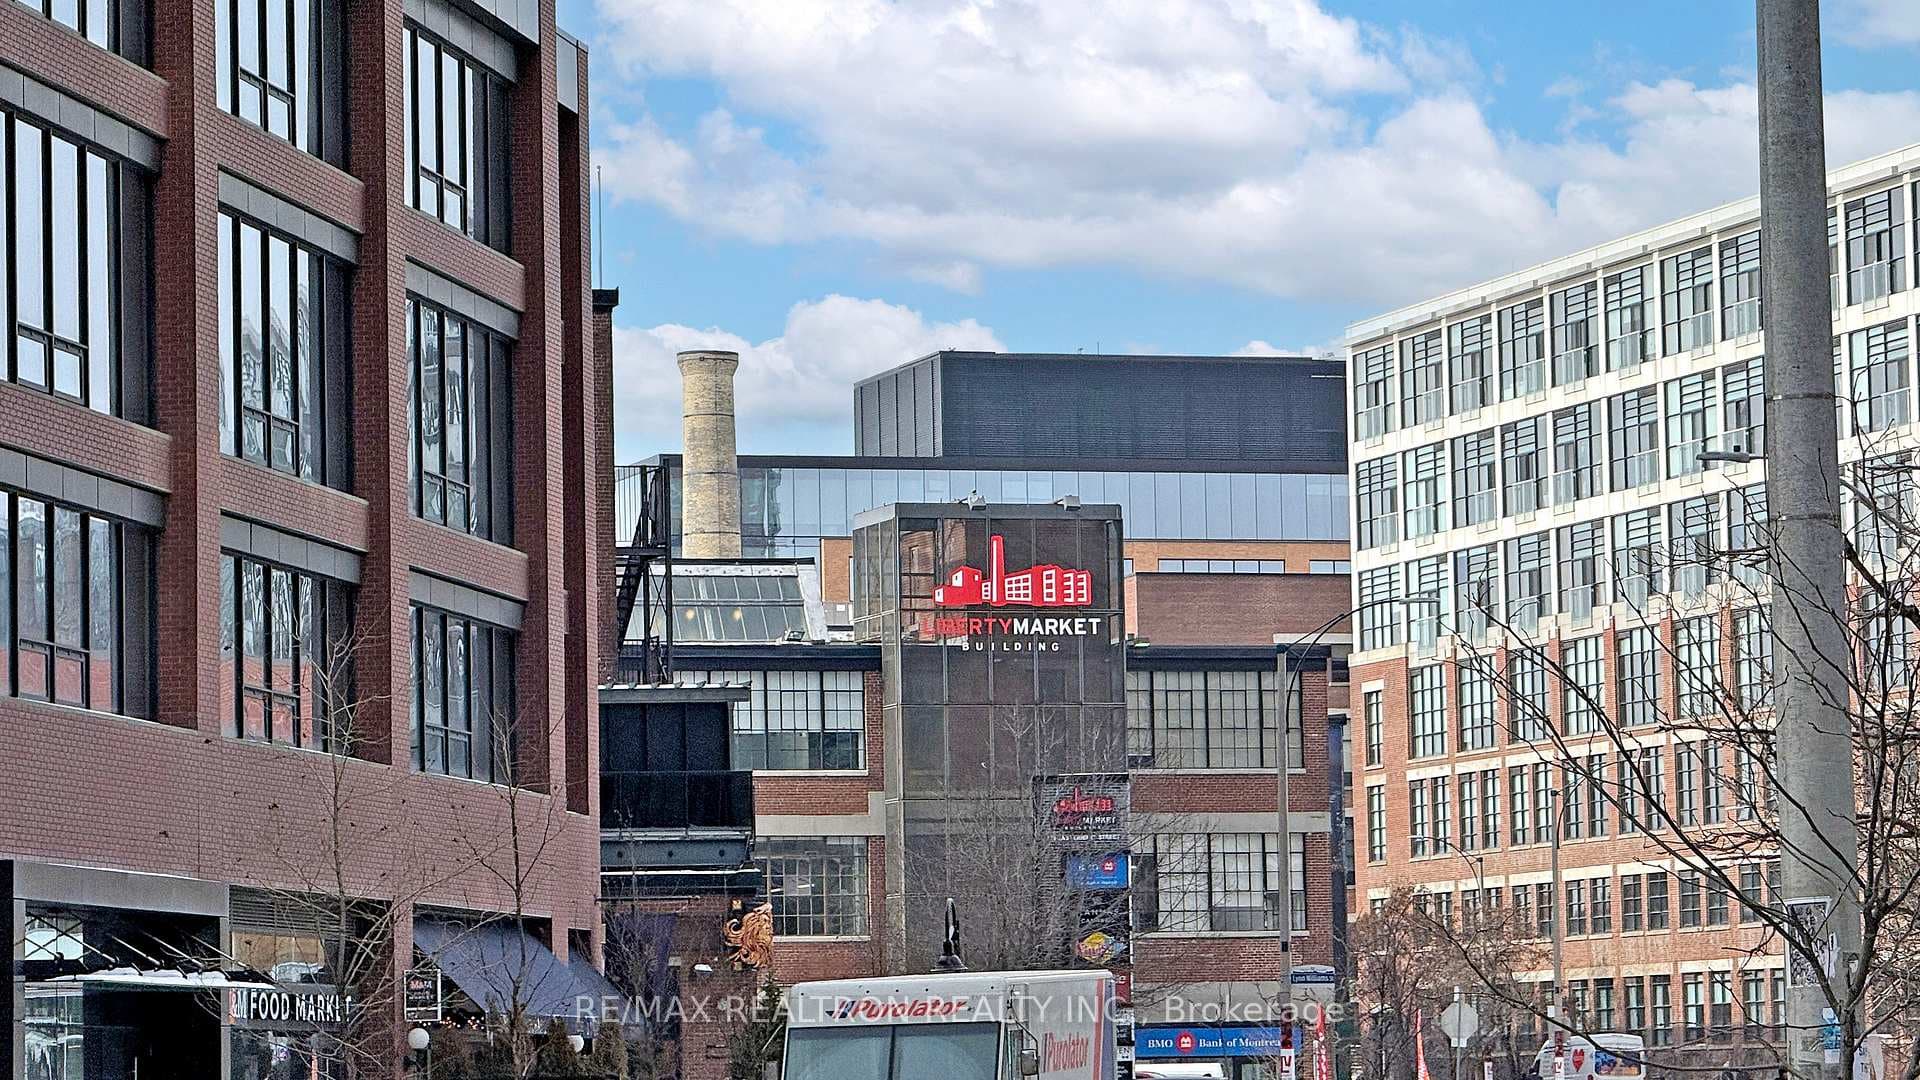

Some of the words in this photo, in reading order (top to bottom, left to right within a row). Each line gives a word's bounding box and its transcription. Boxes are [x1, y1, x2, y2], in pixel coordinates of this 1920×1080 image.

[961, 641, 1060, 652] BUILDING
[250, 988, 290, 1020] FOOD
[852, 999, 968, 1019] Purolator
[1047, 1031, 1089, 1073] Purolator
[1148, 1038, 1174, 1048] BMO
[1226, 1037, 1237, 1048] of
[1238, 1037, 1281, 1048] Montrea
